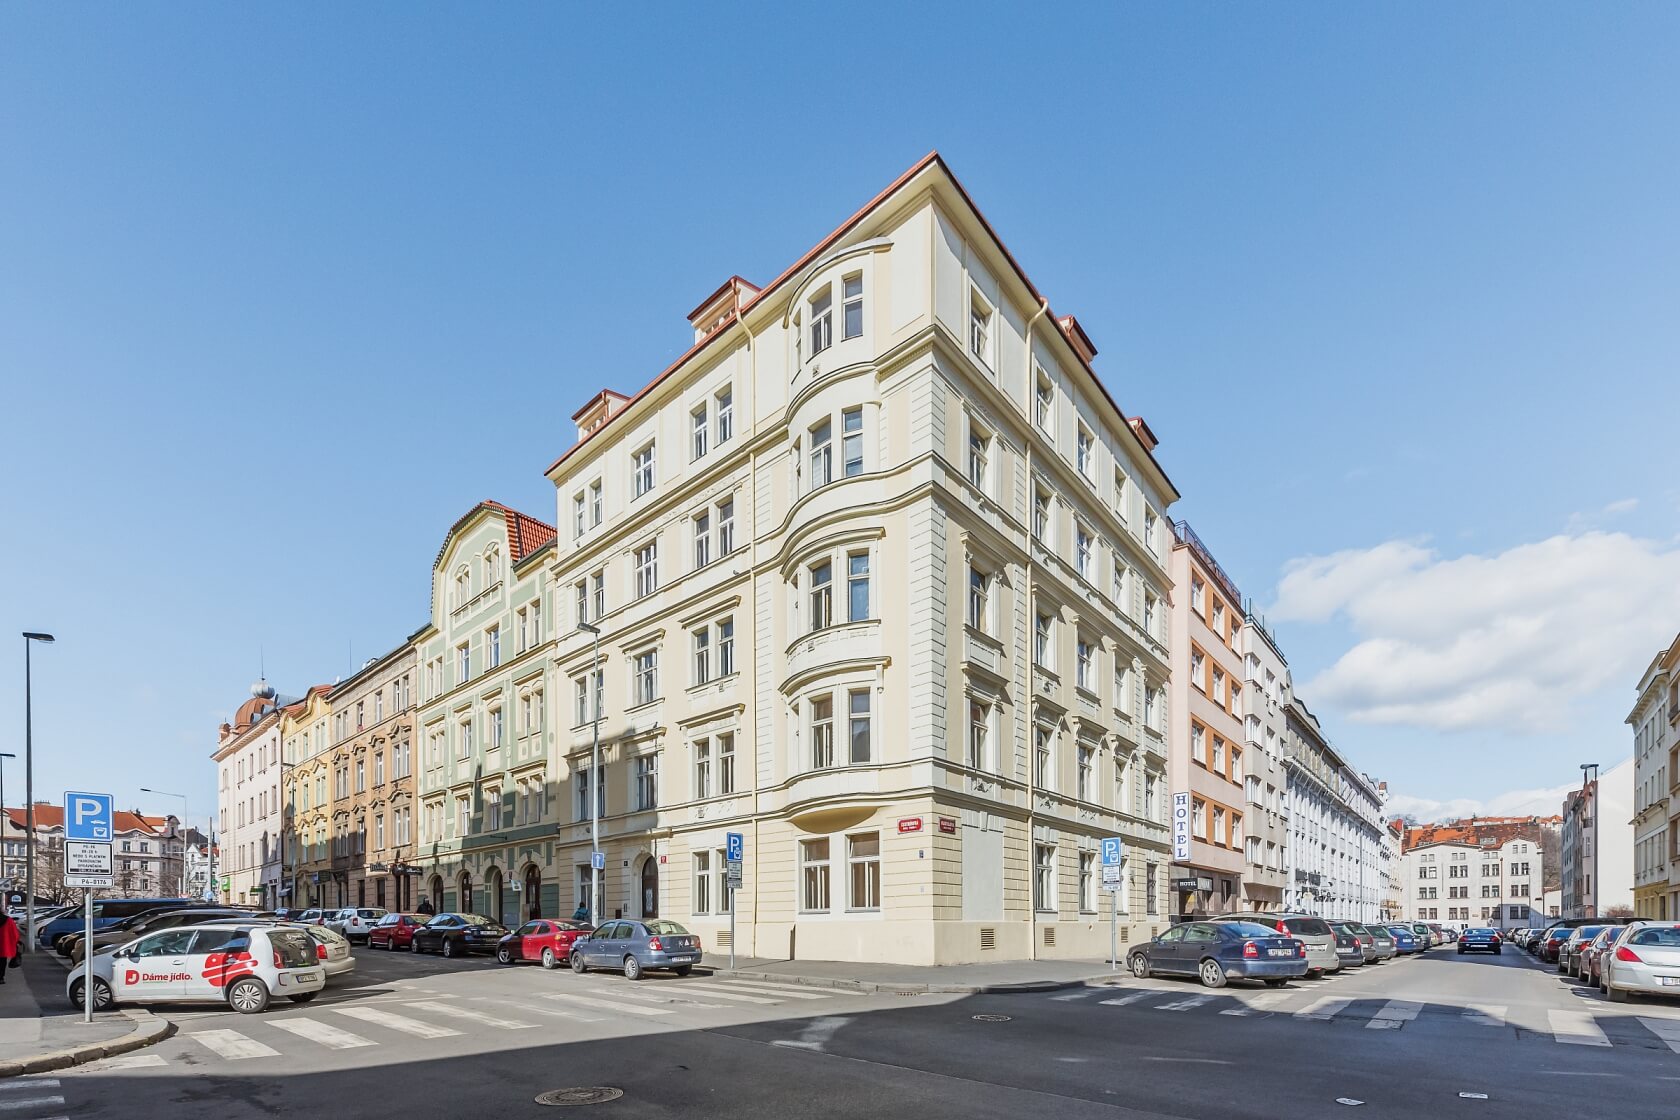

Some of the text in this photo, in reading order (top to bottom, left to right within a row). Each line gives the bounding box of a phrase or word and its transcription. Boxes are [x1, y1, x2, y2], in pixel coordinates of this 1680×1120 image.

[75, 798, 102, 825] P
[1175, 794, 1187, 858] HOTEL
[730, 836, 739, 853] P
[1105, 841, 1116, 857] P
[142, 972, 193, 982] Dáme jídlo.
